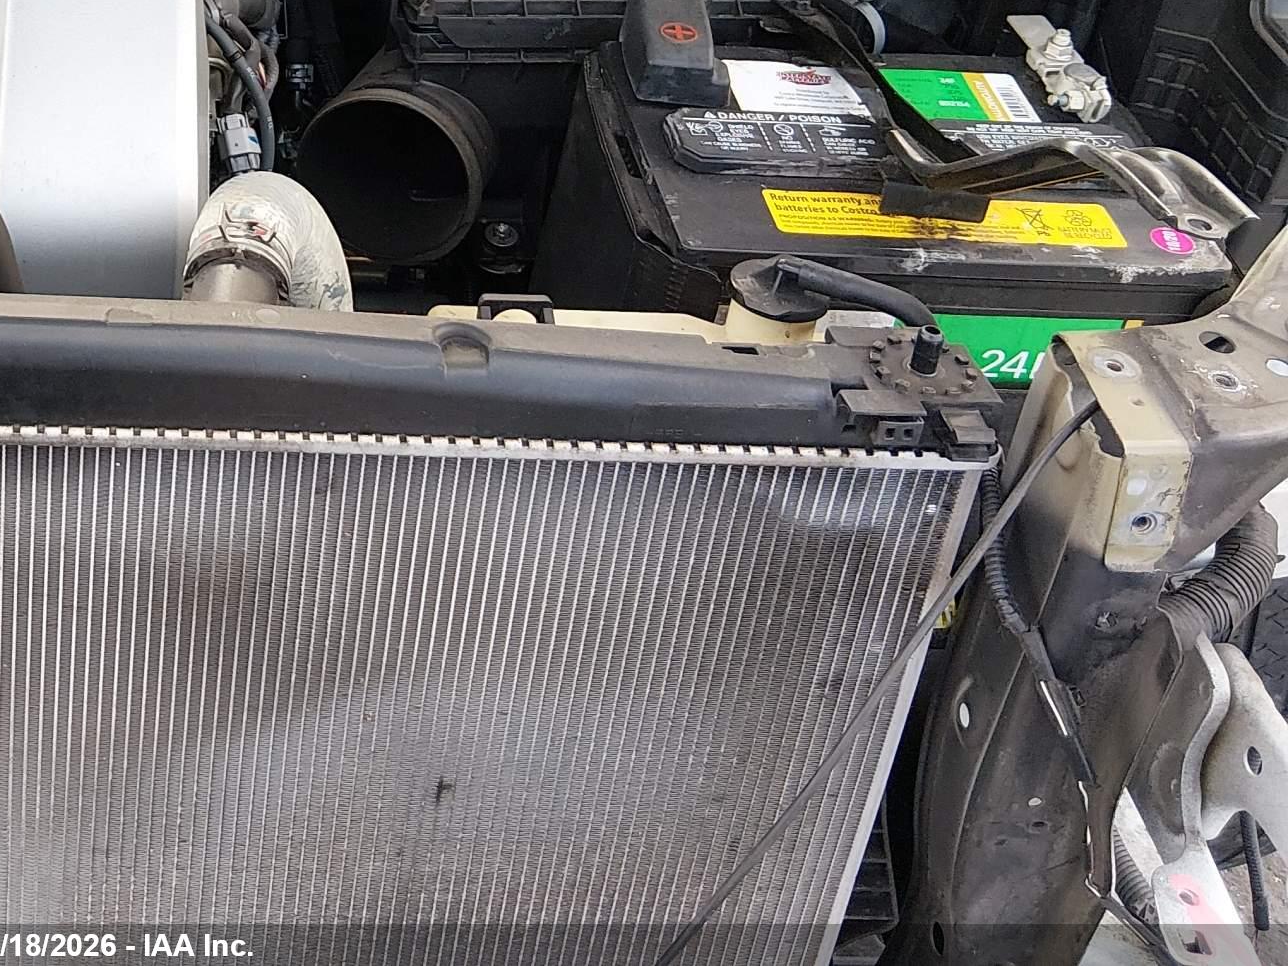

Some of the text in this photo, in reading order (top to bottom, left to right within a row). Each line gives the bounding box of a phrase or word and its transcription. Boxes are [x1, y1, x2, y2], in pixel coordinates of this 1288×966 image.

[716, 111, 842, 124] DANGER / POISON
[770, 192, 883, 206] Return warranty an
[775, 202, 826, 214] batteries
[827, 205, 840, 214] to
